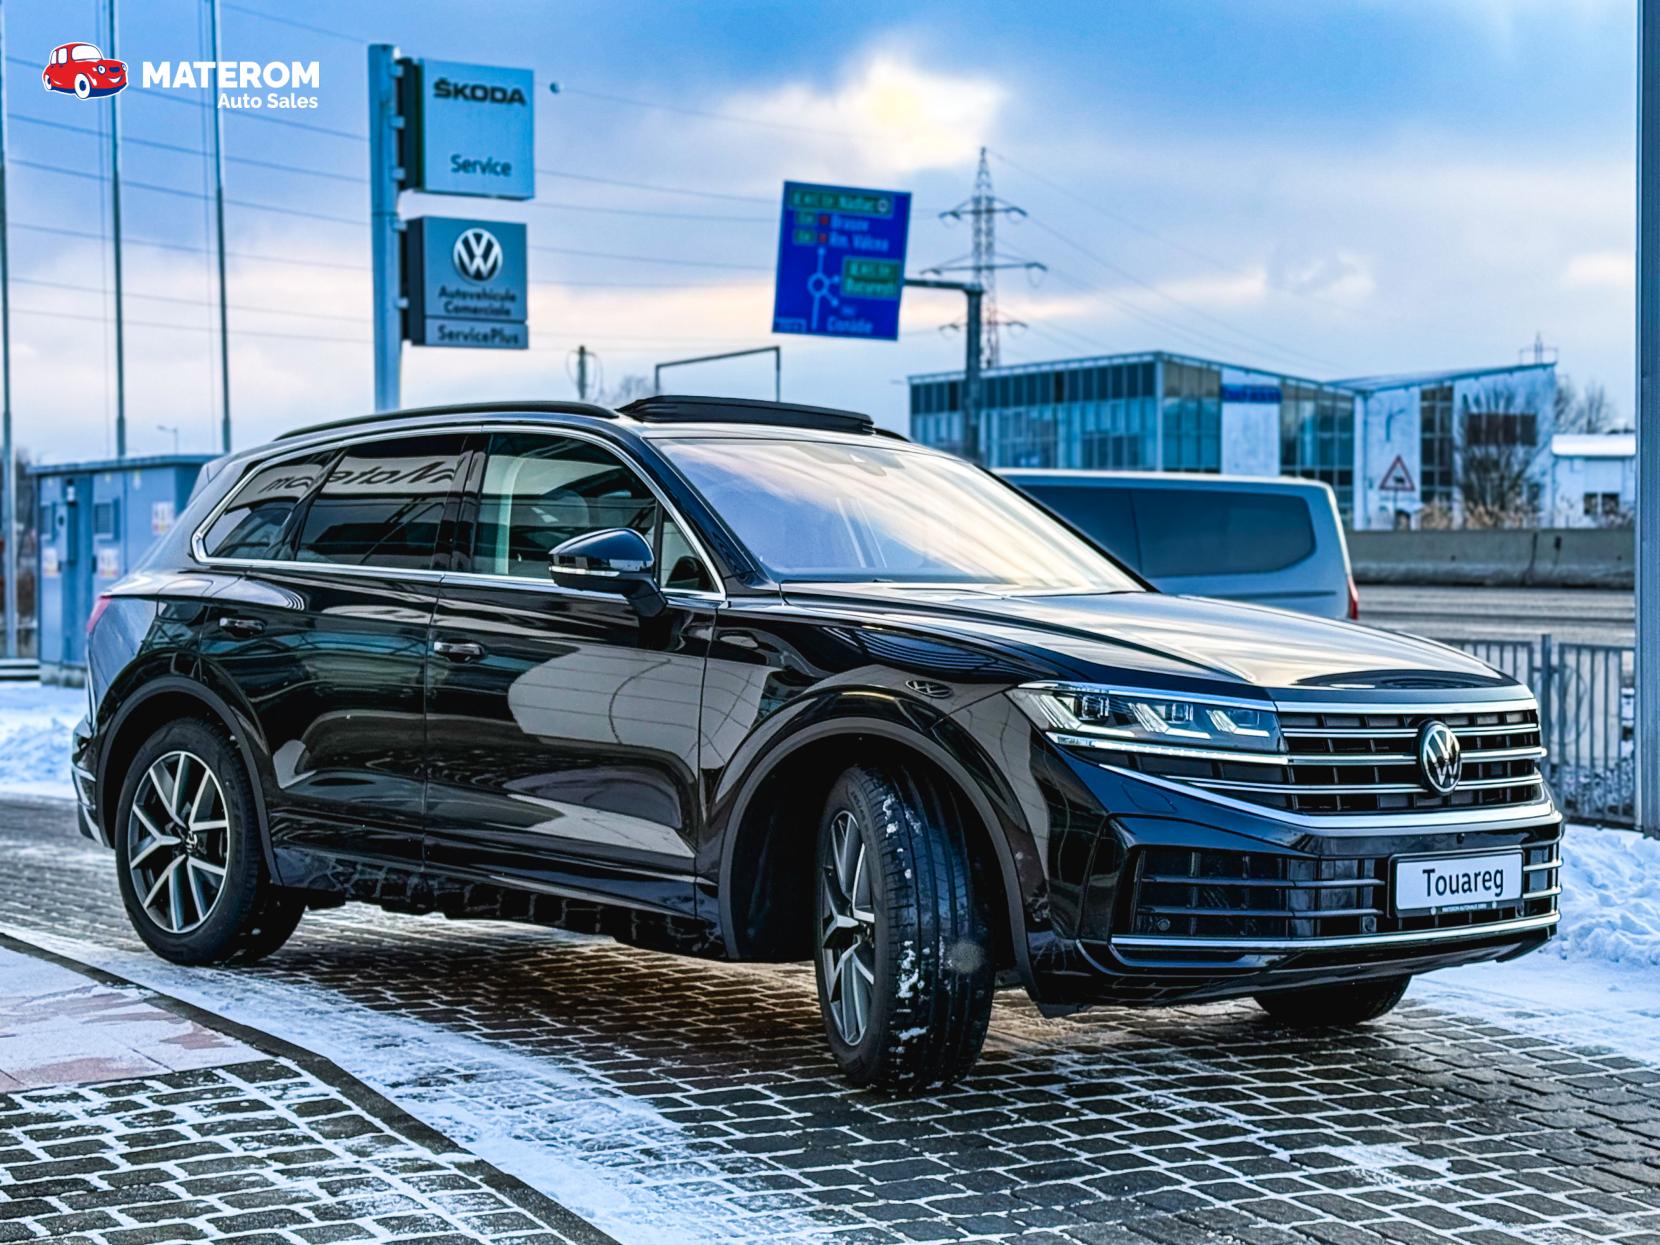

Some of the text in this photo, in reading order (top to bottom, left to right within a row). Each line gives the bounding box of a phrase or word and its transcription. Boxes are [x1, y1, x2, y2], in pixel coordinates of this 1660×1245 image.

[433, 77, 527, 107] ŠKODA
[450, 153, 513, 177] Service
[1422, 868, 1504, 898] Touareg
